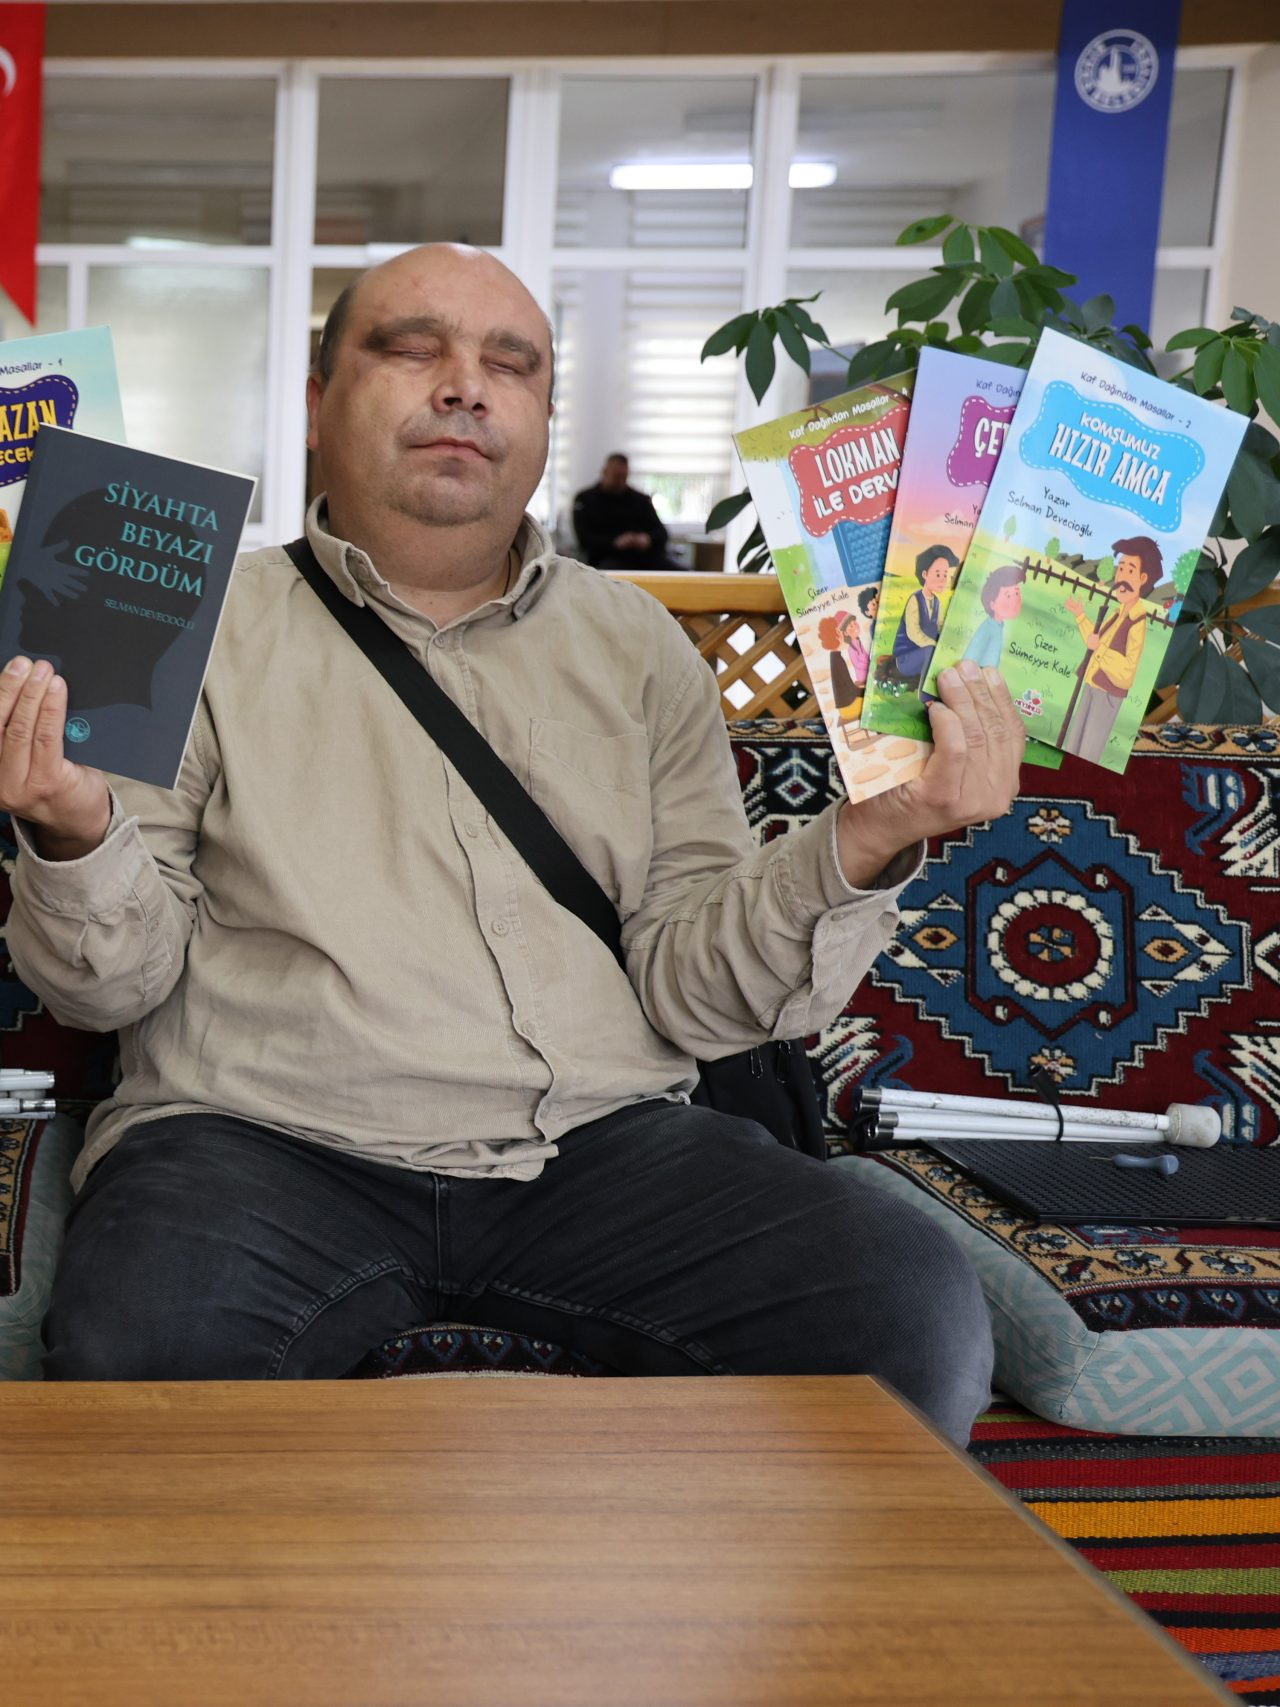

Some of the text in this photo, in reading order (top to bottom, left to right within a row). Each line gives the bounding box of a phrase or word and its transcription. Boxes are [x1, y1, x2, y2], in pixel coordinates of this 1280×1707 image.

[0, 361, 43, 376] Masallar
[57, 358, 63, 367] 1
[975, 379, 993, 390] Kaf
[788, 426, 805, 440] Kaf
[807, 410, 849, 433] Dağından
[851, 395, 890, 416] Masallar
[901, 387, 908, 396] 4
[1080, 371, 1097, 385] Kaf
[1099, 379, 1137, 404] Dağından
[1139, 399, 1175, 420] Masallar
[1185, 420, 1192, 429] 2
[814, 427, 901, 489] LOKMAN
[974, 416, 1011, 459] ÇE
[1080, 411, 1161, 460] KOMŞUMUZ
[1048, 423, 1172, 506] HIZIR AMCA
[104, 480, 219, 532] SİYAHTA
[812, 464, 900, 519] İLE DERV
[1007, 490, 1093, 538] Selman Devecioğlu
[1043, 486, 1071, 508] Yazar
[120, 520, 214, 565] BEYAZI
[944, 512, 975, 529] Selman
[74, 545, 203, 598] GÖRDÜM
[831, 590, 850, 604] Kale
[1008, 641, 1072, 679] Sümeyye Kale
[1034, 634, 1059, 654] Çizer
